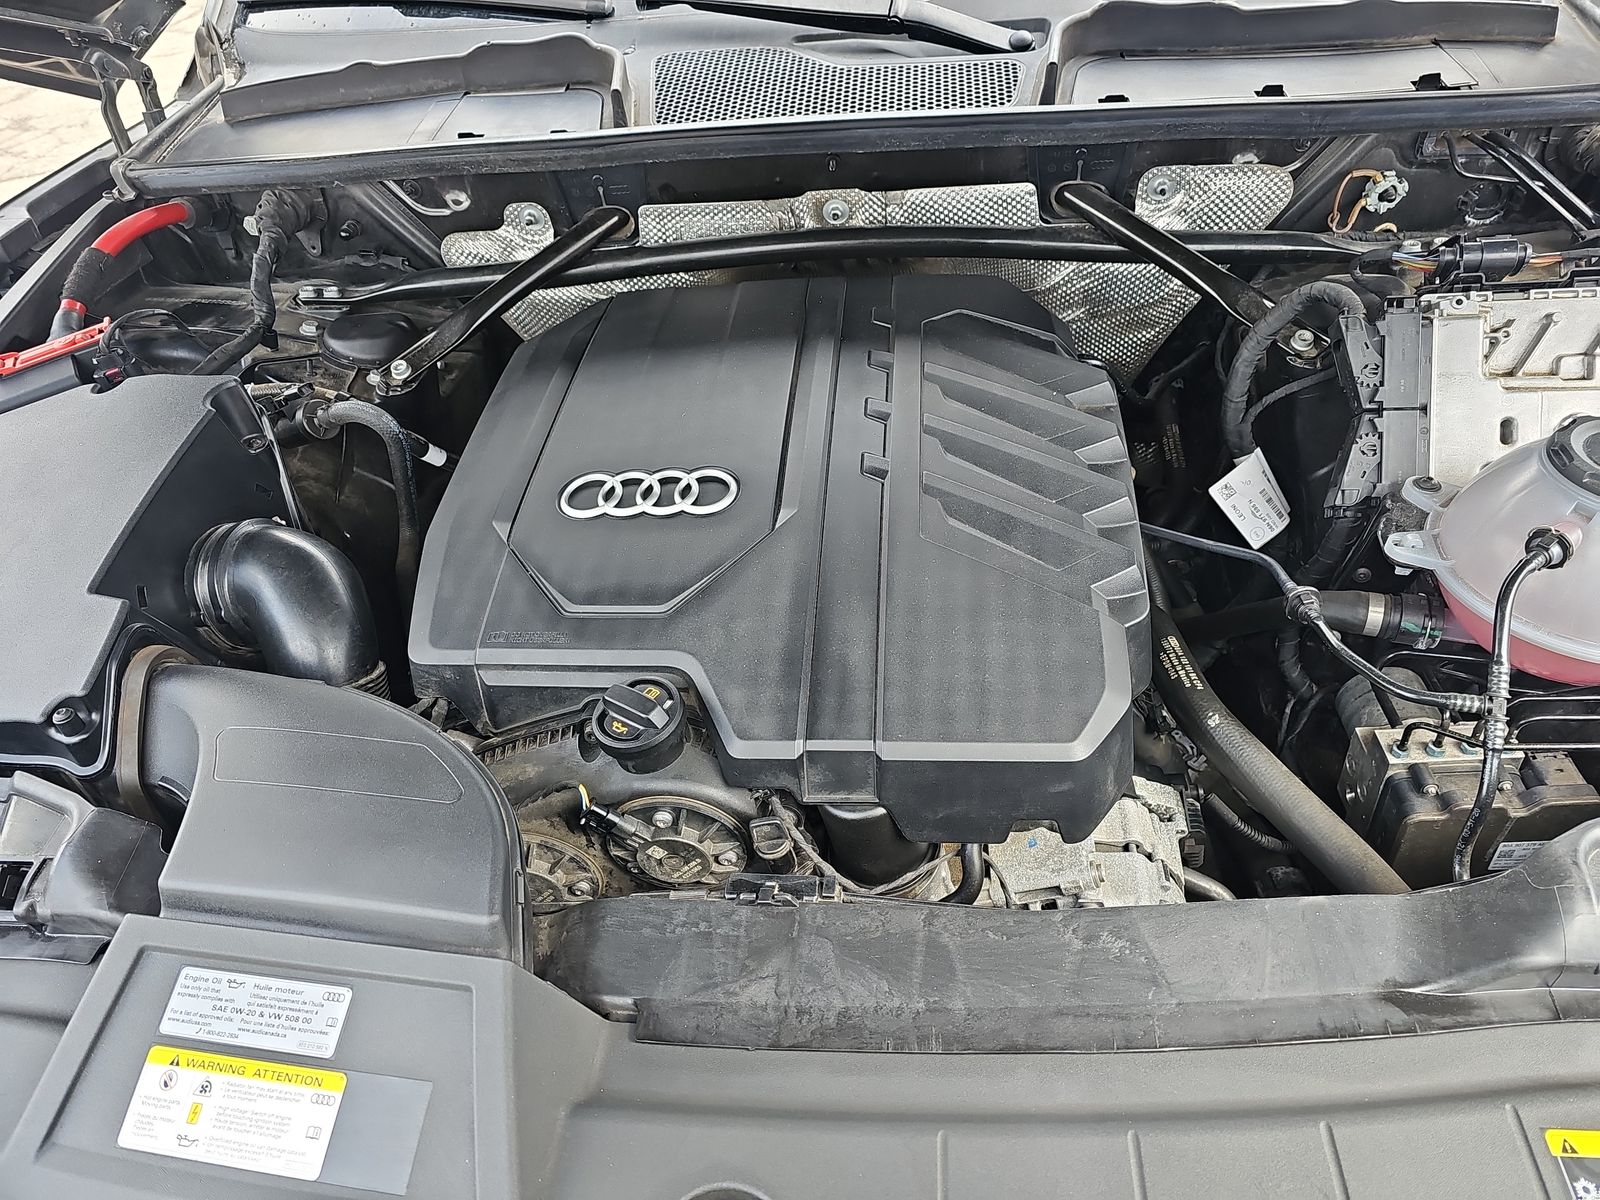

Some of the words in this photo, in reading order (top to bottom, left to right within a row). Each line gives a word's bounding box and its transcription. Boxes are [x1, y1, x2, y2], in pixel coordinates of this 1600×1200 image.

[1230, 504, 1246, 521] LEONI
[184, 974, 209, 983] Engine
[253, 983, 272, 992] Huile
[275, 987, 304, 996] moteur
[212, 1004, 228, 1012] SAE
[230, 1007, 256, 1016] 0W-20
[285, 1014, 300, 1023] 508
[186, 1058, 246, 1075] WARNING
[252, 1069, 324, 1087] ATTENTION
